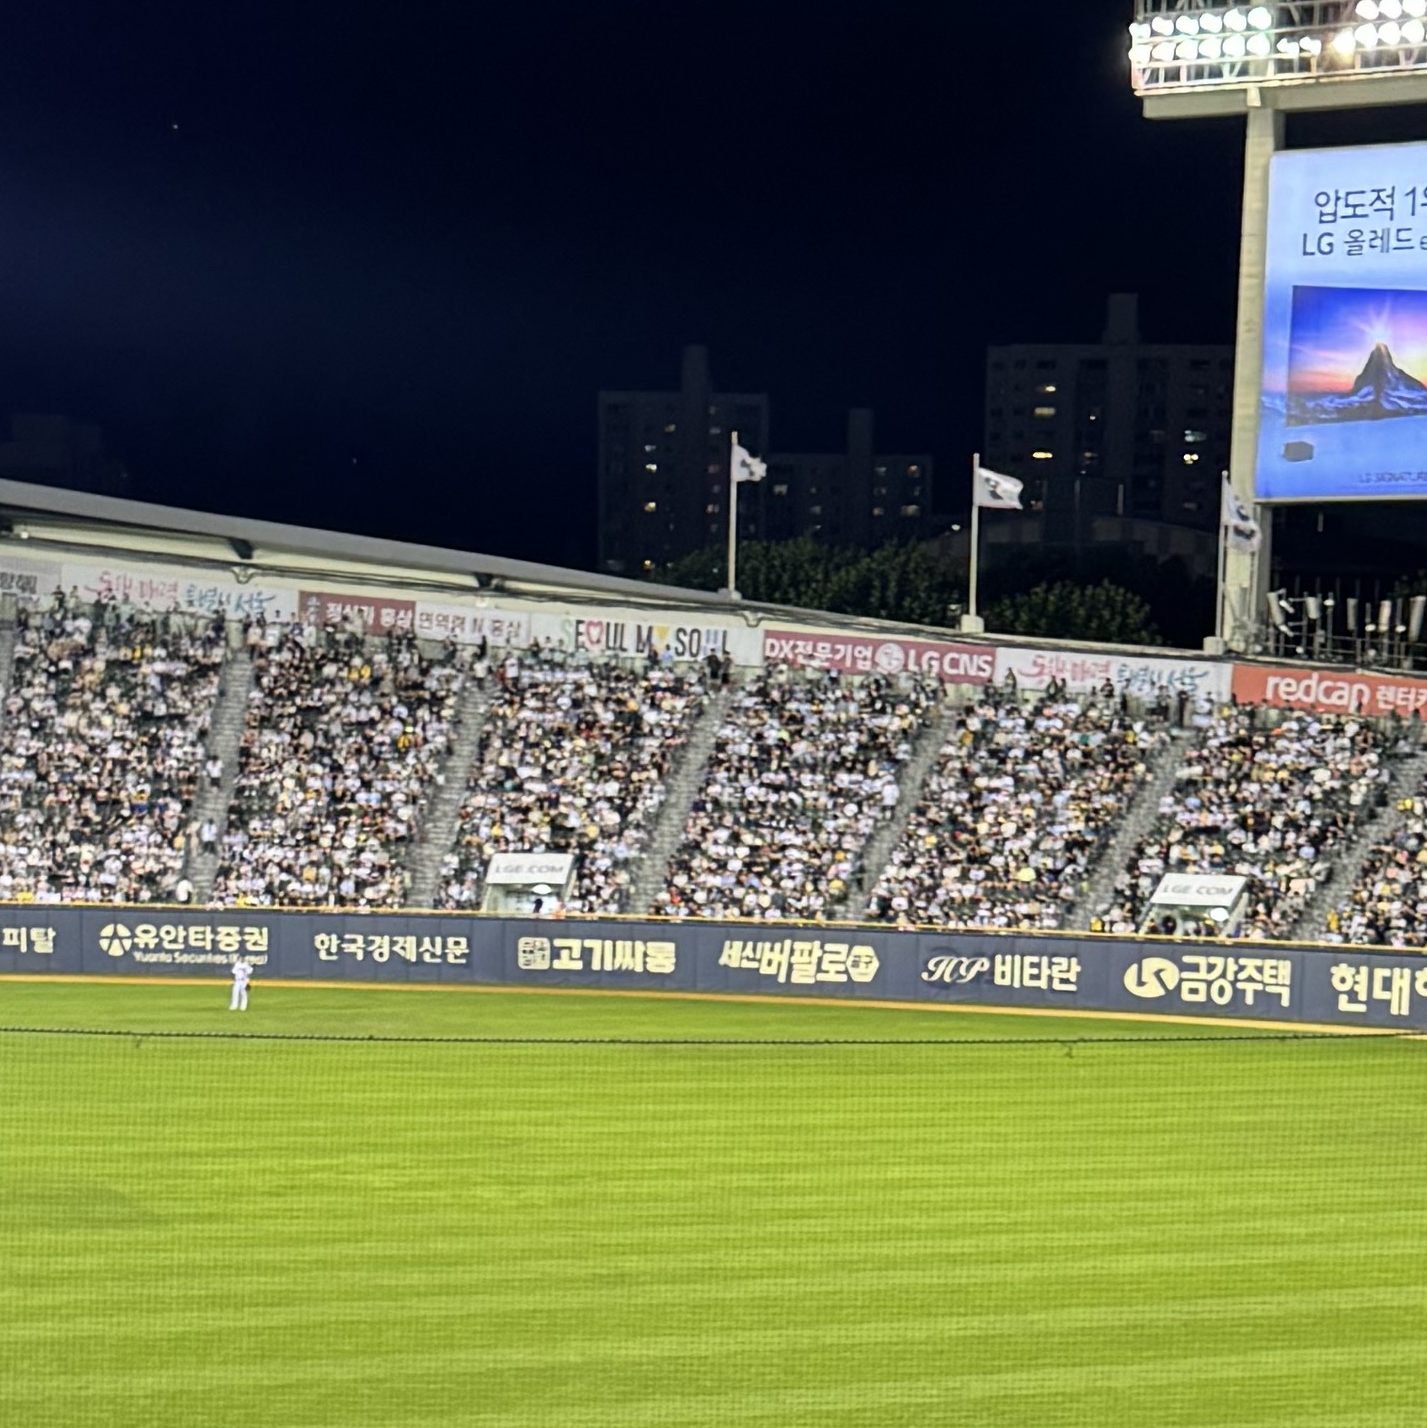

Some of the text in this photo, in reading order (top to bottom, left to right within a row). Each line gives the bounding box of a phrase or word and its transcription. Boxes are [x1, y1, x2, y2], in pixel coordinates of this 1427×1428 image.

[1314, 184, 1396, 224] 압도적
[1302, 231, 1334, 256] LG
[1344, 228, 1415, 256] 올레드
[563, 617, 625, 653] SEOUL
[675, 627, 728, 658] SOUL
[764, 637, 873, 670] DX전문기업
[907, 651, 994, 678] LG CNS
[1265, 671, 1370, 713] redcap
[134, 923, 270, 952] 유안타증권
[314, 932, 470, 965] 한국경제신문
[552, 937, 676, 974] 고기싸롱
[718, 939, 849, 984] 세신버팔로
[993, 953, 1082, 992] 비타란
[1180, 954, 1292, 1008] 금강주택
